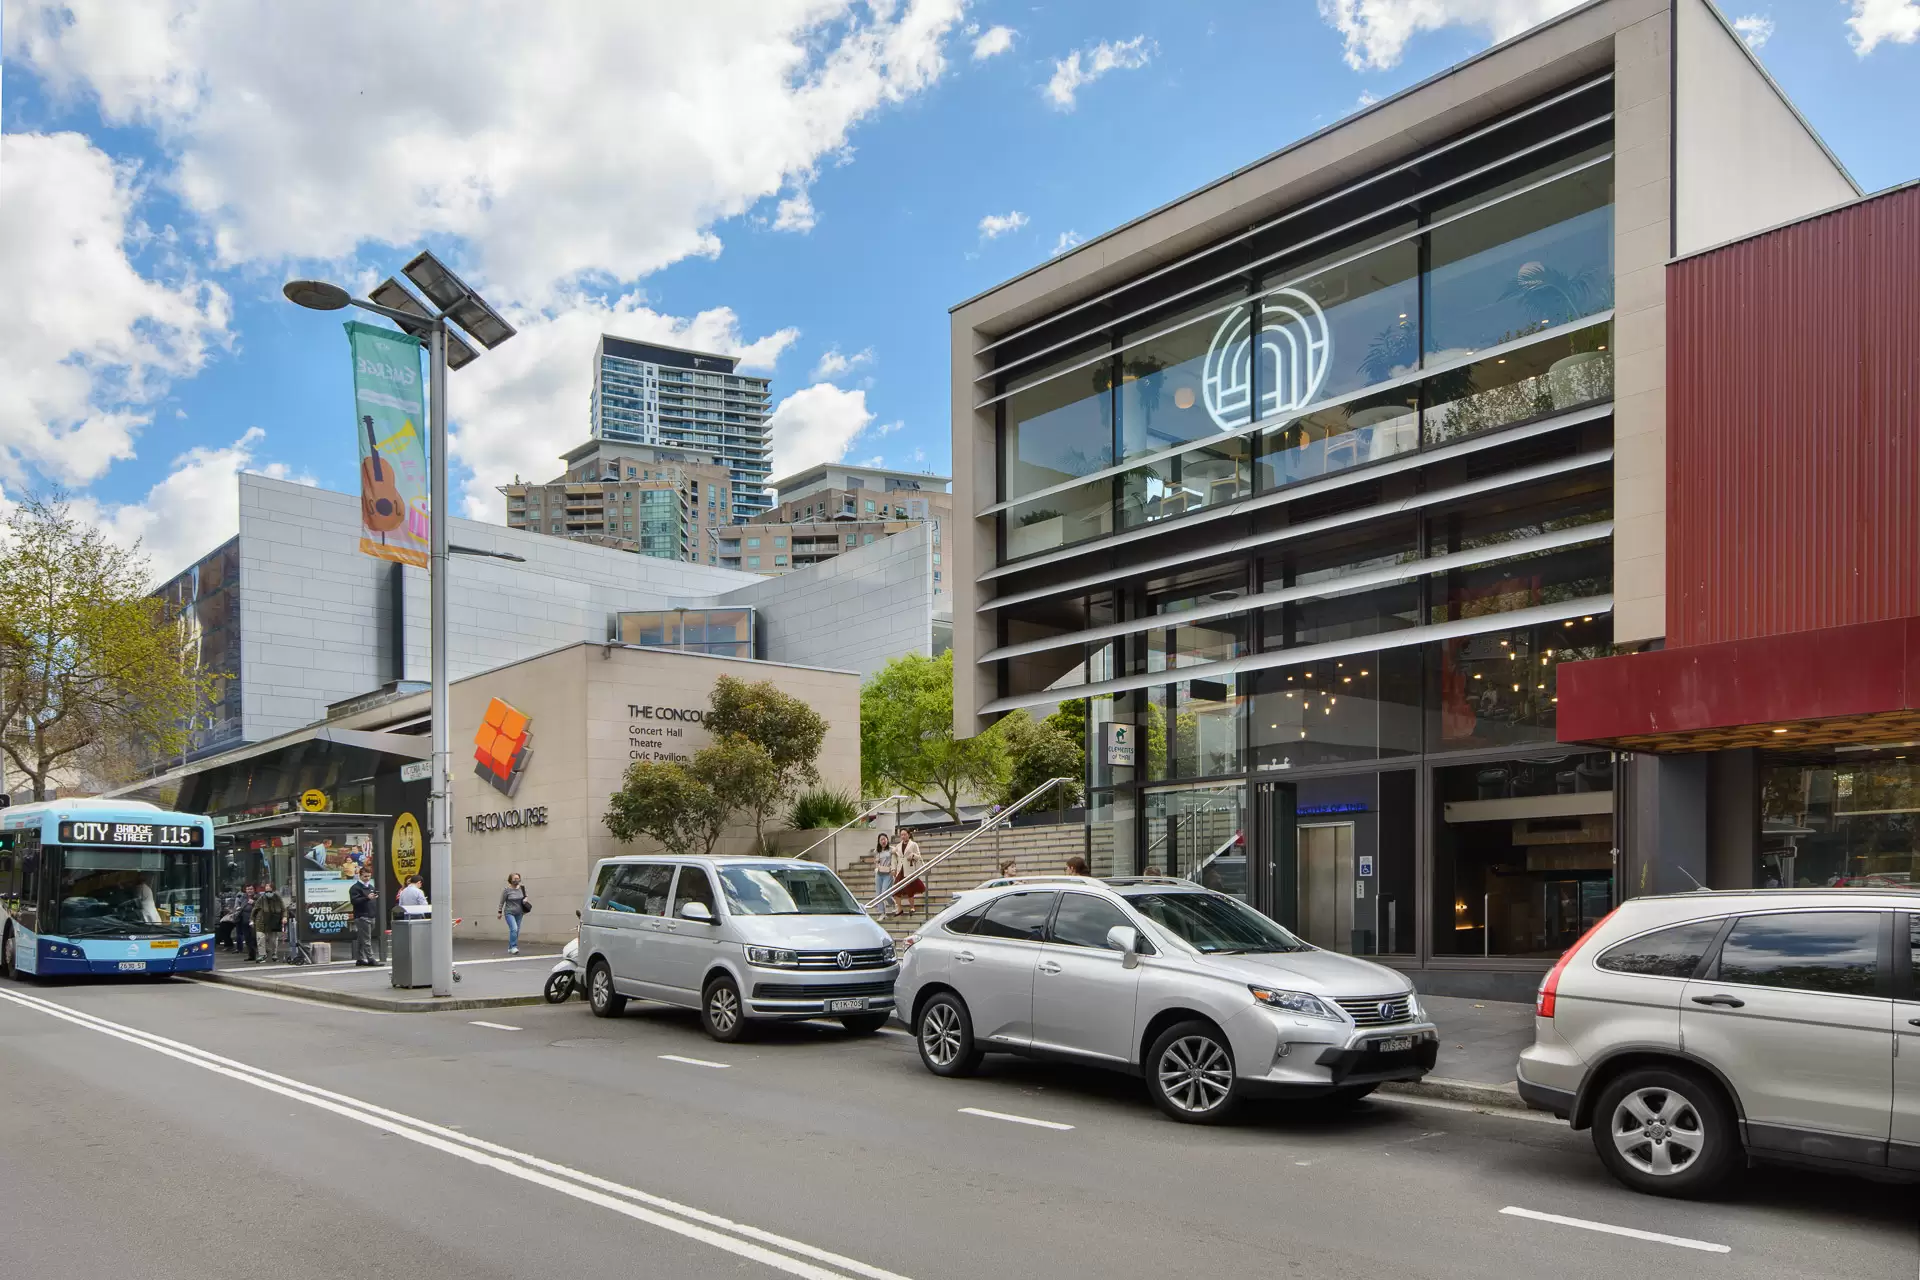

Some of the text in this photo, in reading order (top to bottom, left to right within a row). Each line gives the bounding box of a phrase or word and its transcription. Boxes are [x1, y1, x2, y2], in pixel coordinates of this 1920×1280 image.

[628, 704, 707, 723] THE CONCOU
[628, 725, 683, 737] Concert Hall
[629, 738, 662, 748] Theatre
[629, 750, 688, 762] Civic Pavilion
[466, 806, 548, 833] THE CONCOURSE
[73, 822, 109, 841] CITY
[115, 824, 153, 833] BRIDGE
[113, 832, 154, 843] STREET
[160, 826, 191, 844] 115
[308, 906, 333, 915] OVER
[326, 913, 349, 922] WAYS
[309, 920, 348, 929] YOU CAN
